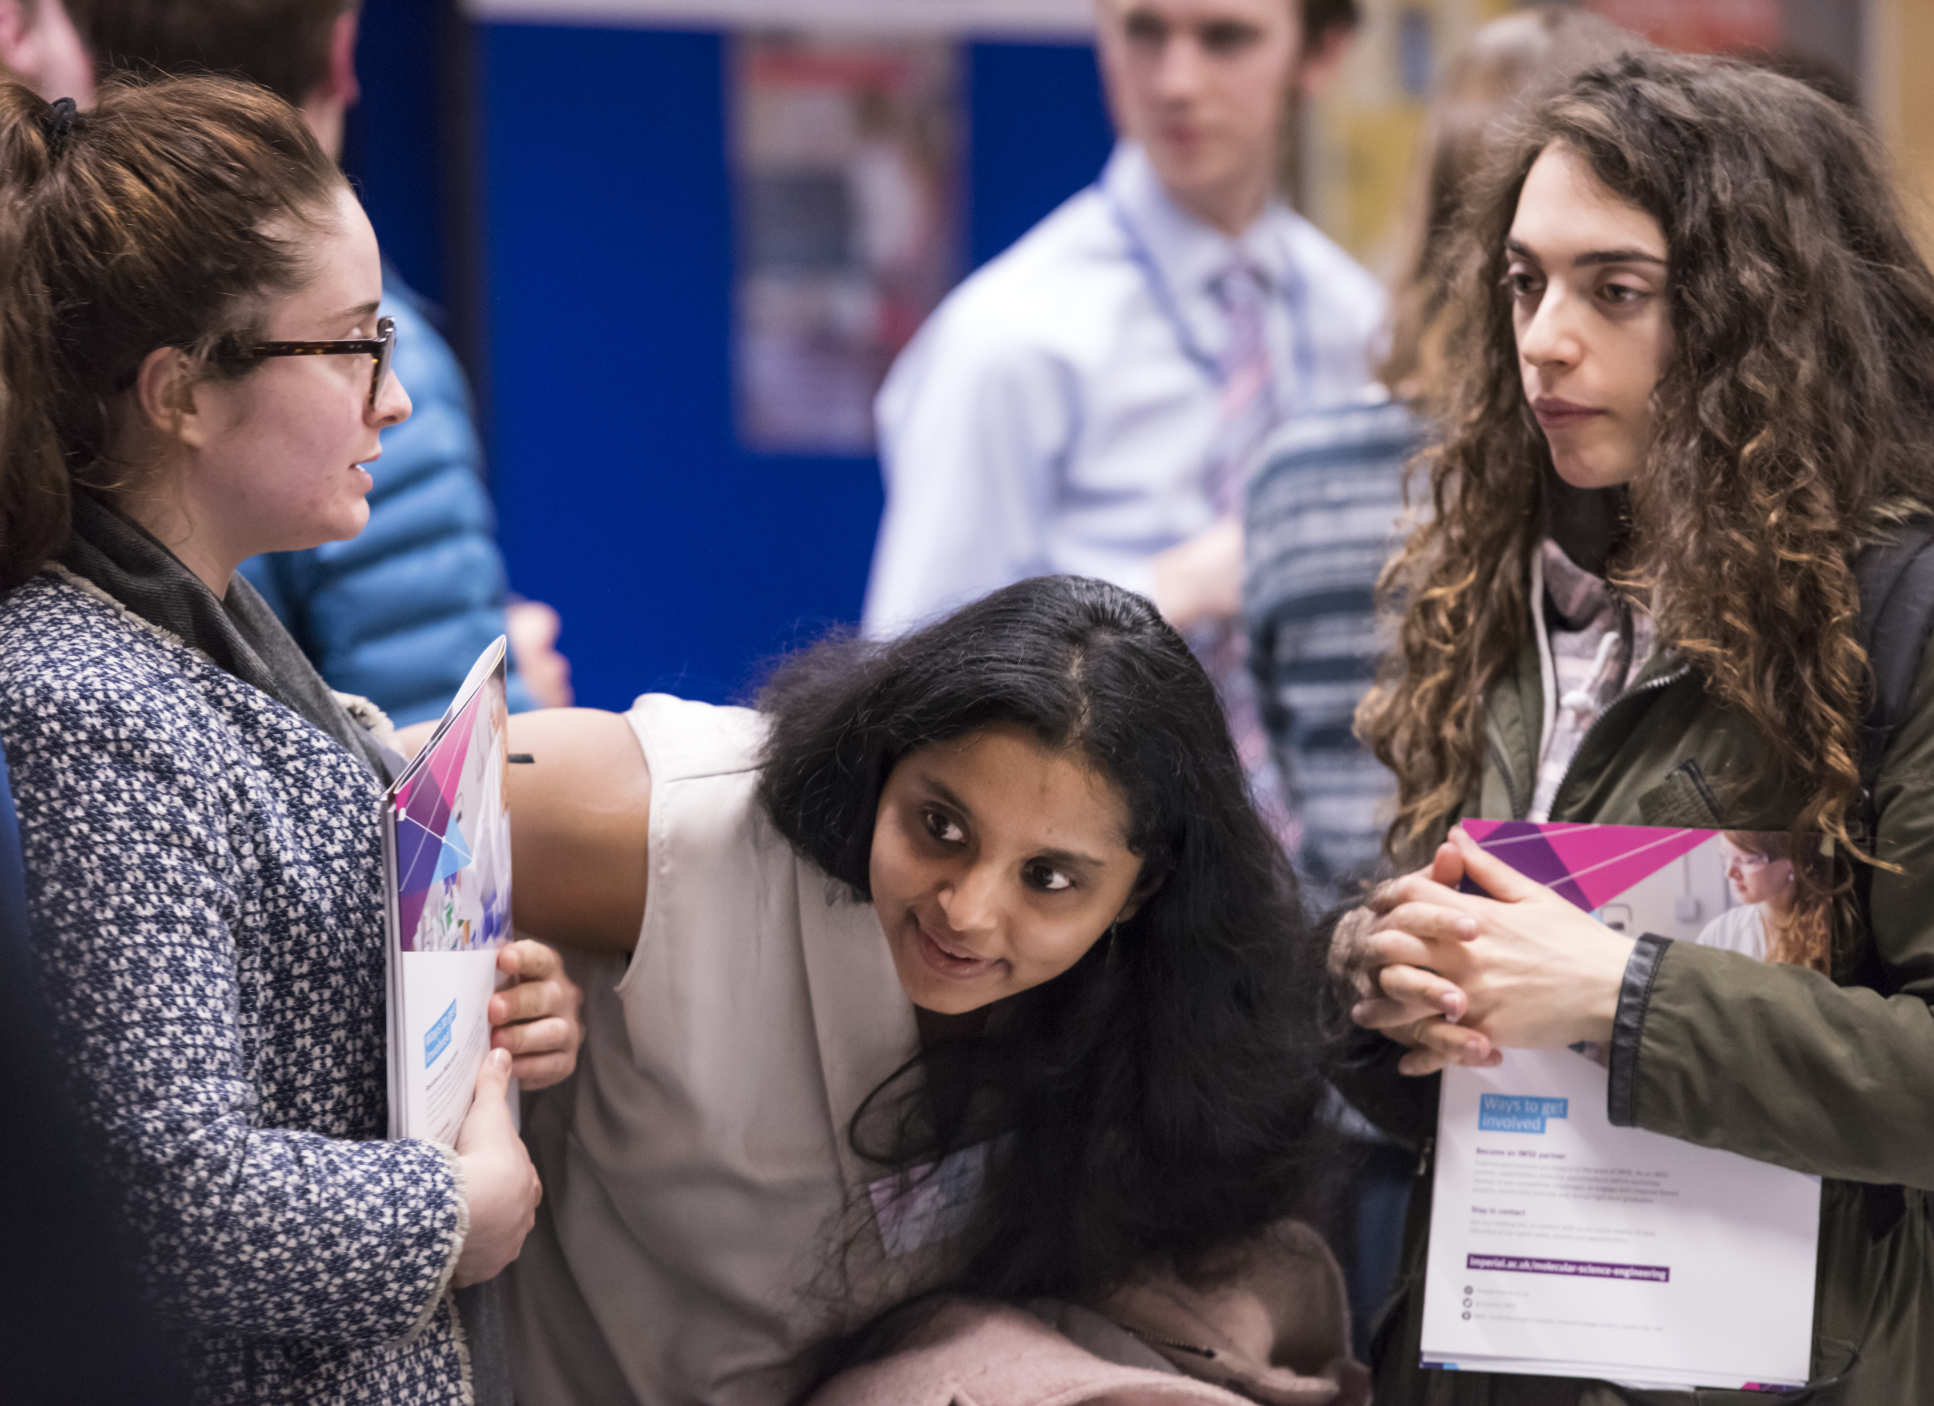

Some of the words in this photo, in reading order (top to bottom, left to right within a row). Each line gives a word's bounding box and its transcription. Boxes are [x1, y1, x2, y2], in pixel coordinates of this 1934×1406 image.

[1483, 1096, 1520, 1115] Ways
[1525, 1098, 1539, 1112] to
[1541, 1100, 1565, 1117] get
[1482, 1114, 1542, 1131] involved
[1499, 1208, 1526, 1217] contact
[1469, 1257, 1667, 1281] imperial.ac.uk/molecular-science-engineering
